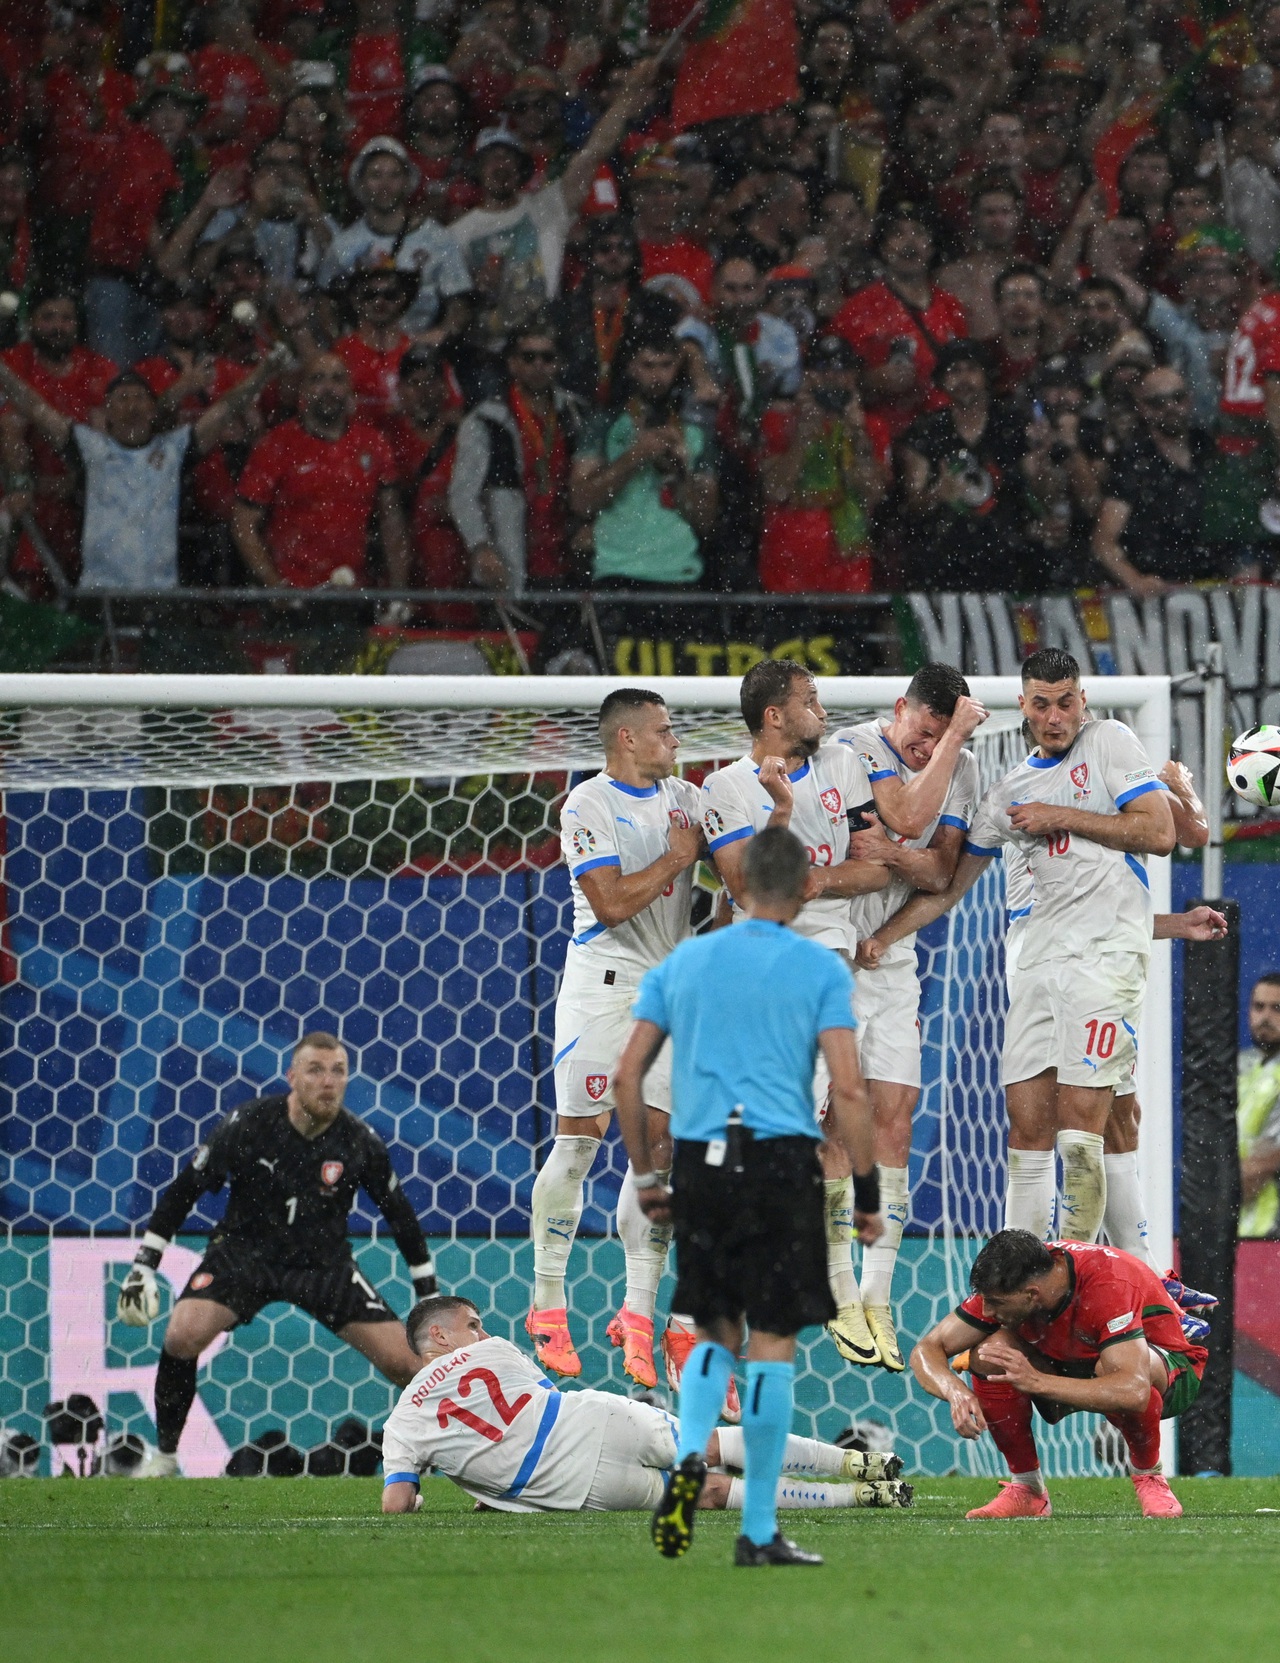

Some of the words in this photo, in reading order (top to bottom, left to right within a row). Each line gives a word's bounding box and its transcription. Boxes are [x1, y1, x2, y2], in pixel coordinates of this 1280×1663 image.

[1084, 1018, 1117, 1059] 10
[285, 1196, 298, 1226] 1
[547, 1217, 574, 1227] CZE
[351, 1270, 377, 1301] 1
[411, 1352, 471, 1408] DOUDERA
[437, 1367, 533, 1443] 12
